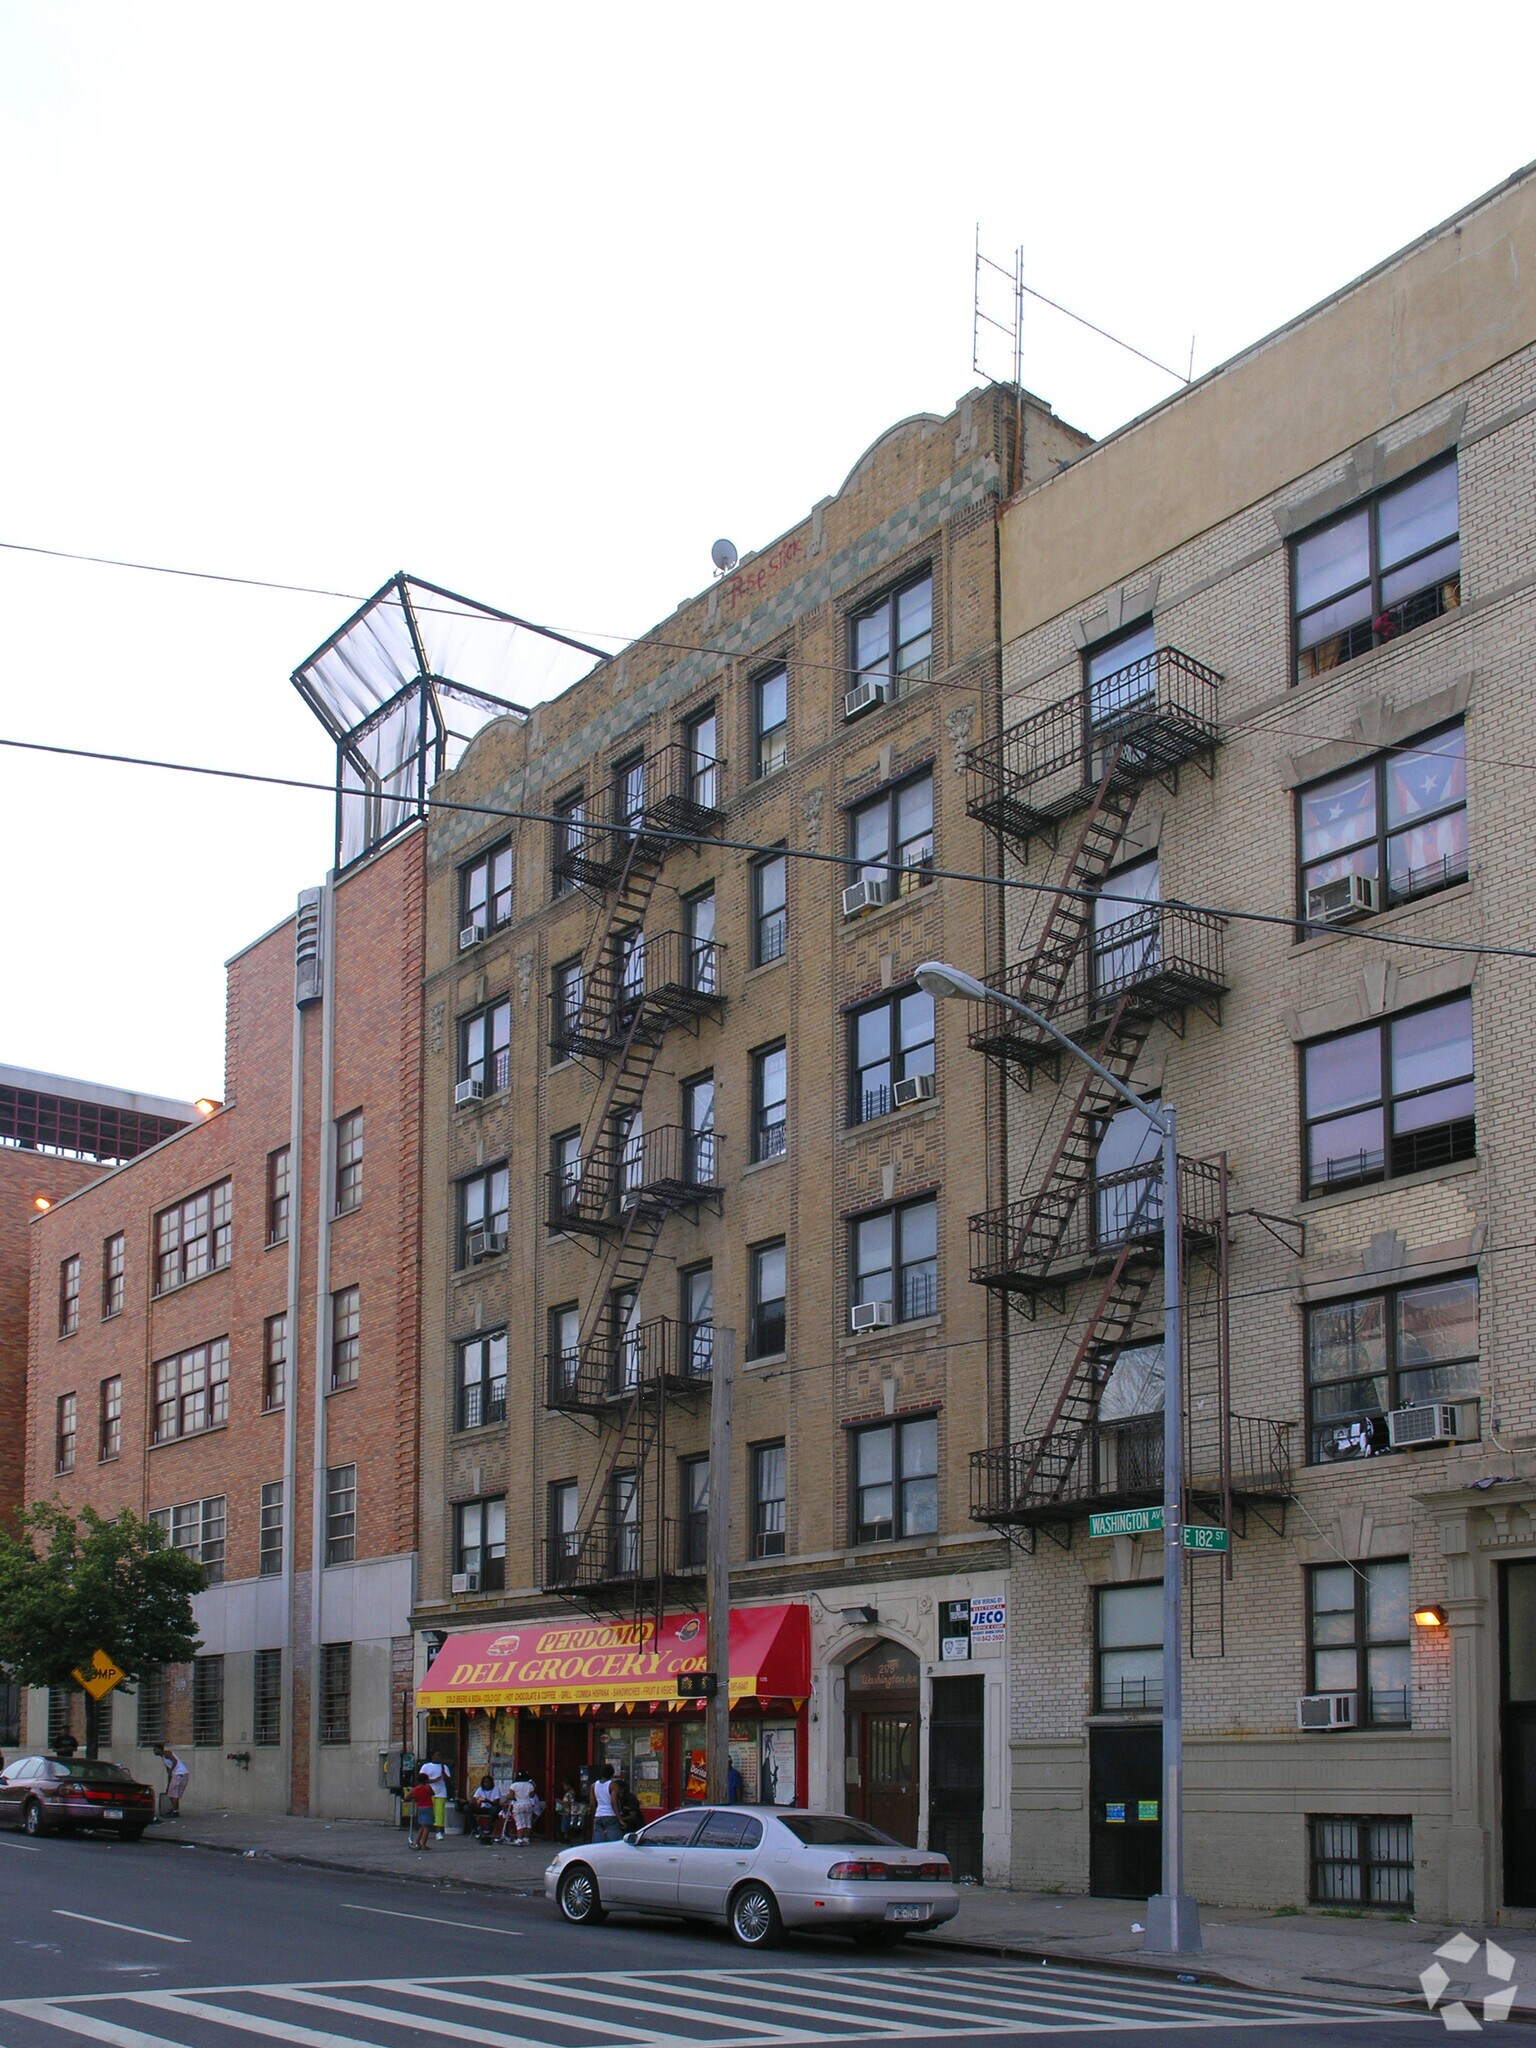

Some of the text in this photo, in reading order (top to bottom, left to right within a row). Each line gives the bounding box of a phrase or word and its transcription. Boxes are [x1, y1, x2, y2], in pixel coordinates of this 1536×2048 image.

[1092, 1511, 1149, 1534] WASHINGTON
[1183, 1528, 1224, 1547] E 182 ST
[972, 1610, 1003, 1625] JECO
[539, 1624, 648, 1652] PERDOMO
[448, 1650, 707, 1685] DELI GROCERY COR
[863, 1674, 905, 1688] Washington
[514, 1691, 537, 1700] CHOCOLATE
[540, 1690, 556, 1700] COFFEE
[613, 1687, 640, 1697] SANDWICHES
[643, 1686, 656, 1695] FRUIT
[660, 1685, 678, 1694] VEGETA
[691, 1765, 707, 1778] Dorito
